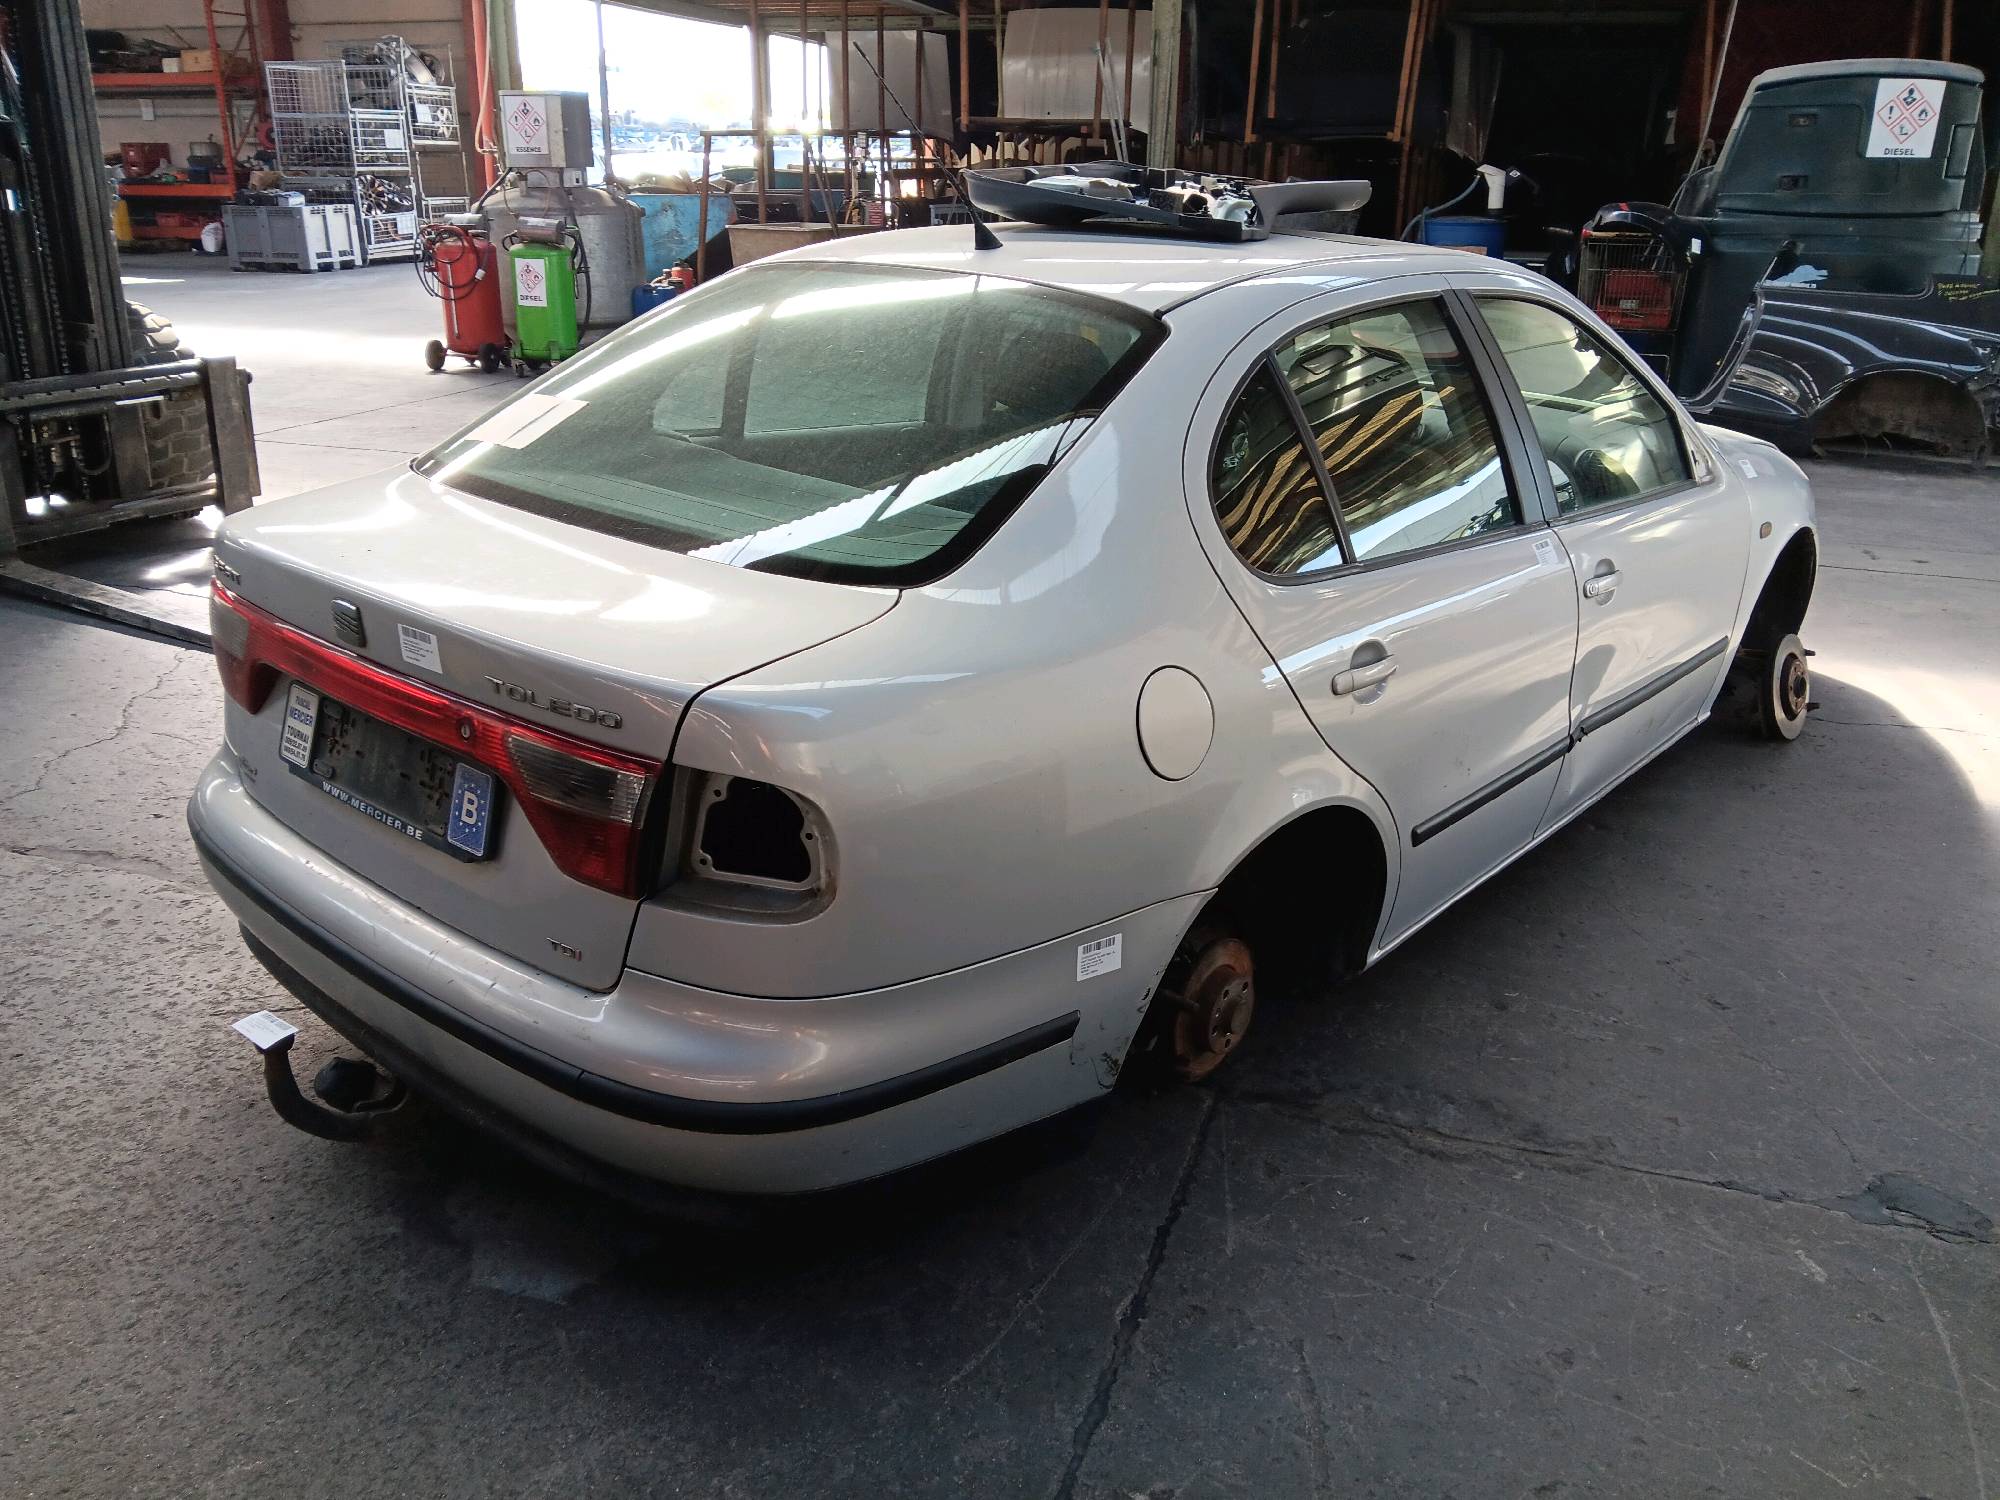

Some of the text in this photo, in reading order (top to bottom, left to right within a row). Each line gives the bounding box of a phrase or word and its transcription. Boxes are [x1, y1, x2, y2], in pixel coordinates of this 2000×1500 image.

[1884, 147, 1915, 156] DIESEL
[519, 294, 543, 302] DIESEL
[484, 674, 623, 729] TOLEDO
[287, 725, 310, 744] TOURNAI
[322, 780, 425, 842] WWW.MERCIER.BE
[460, 790, 479, 825] B
[545, 936, 583, 962] TDI
